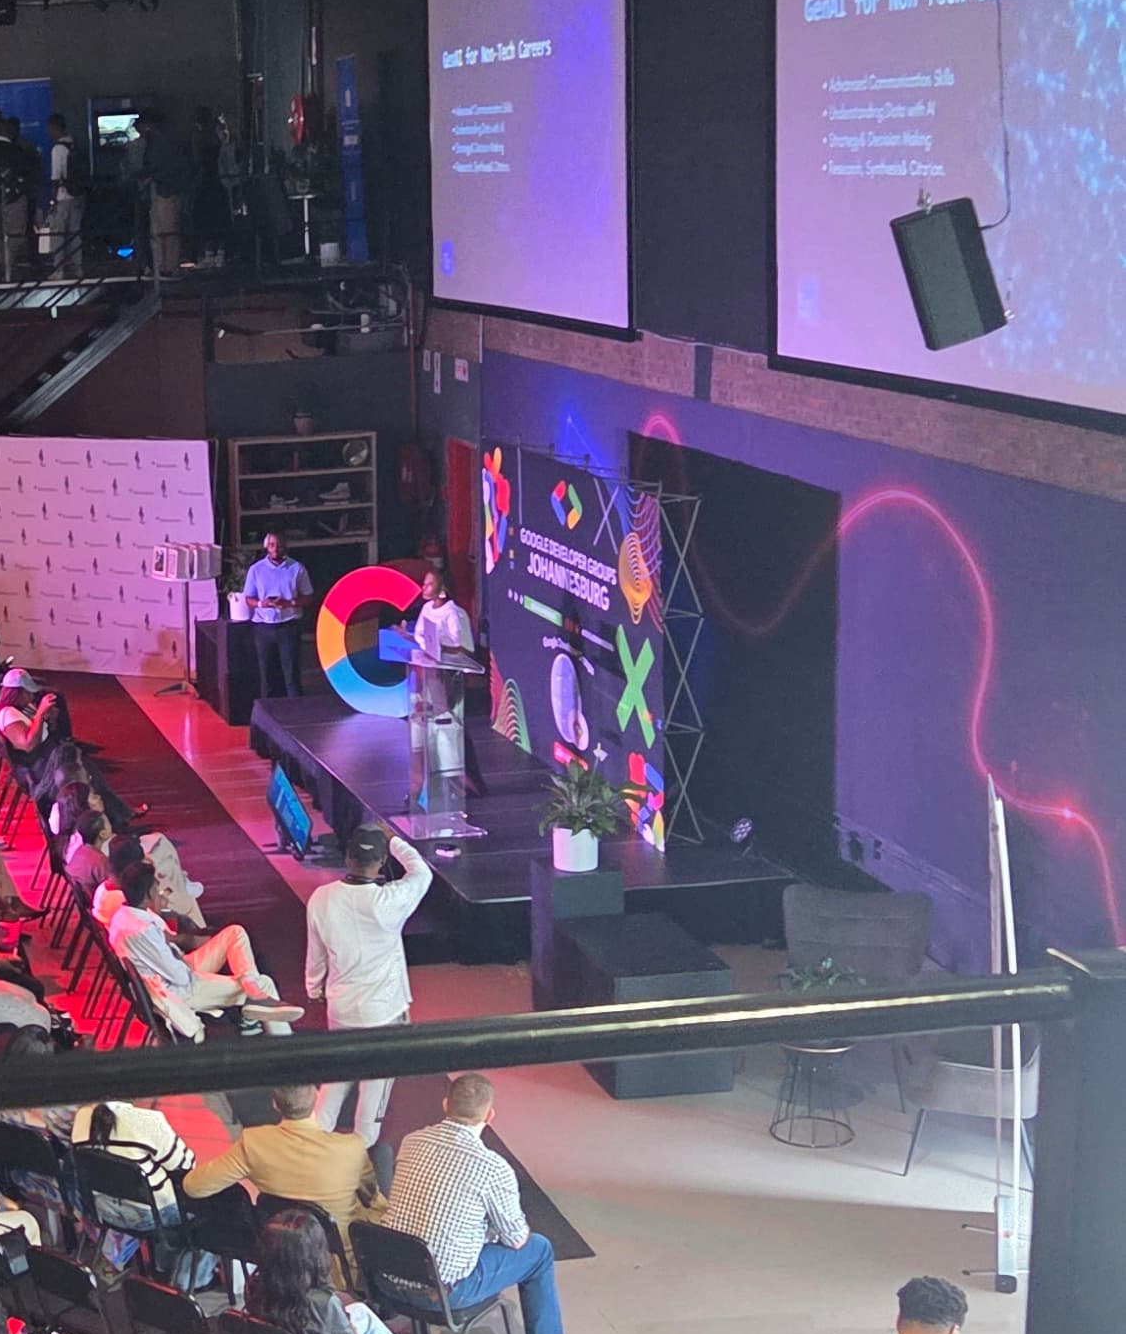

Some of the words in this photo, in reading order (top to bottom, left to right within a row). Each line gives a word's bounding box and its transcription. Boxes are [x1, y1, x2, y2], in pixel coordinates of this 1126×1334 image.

[518, 39, 552, 59] Careers
[520, 528, 550, 553] GOOGLE
[549, 539, 587, 571] DEVELOPER
[587, 557, 617, 585] GROUPS
[527, 552, 610, 611] JOHANNESBURG
